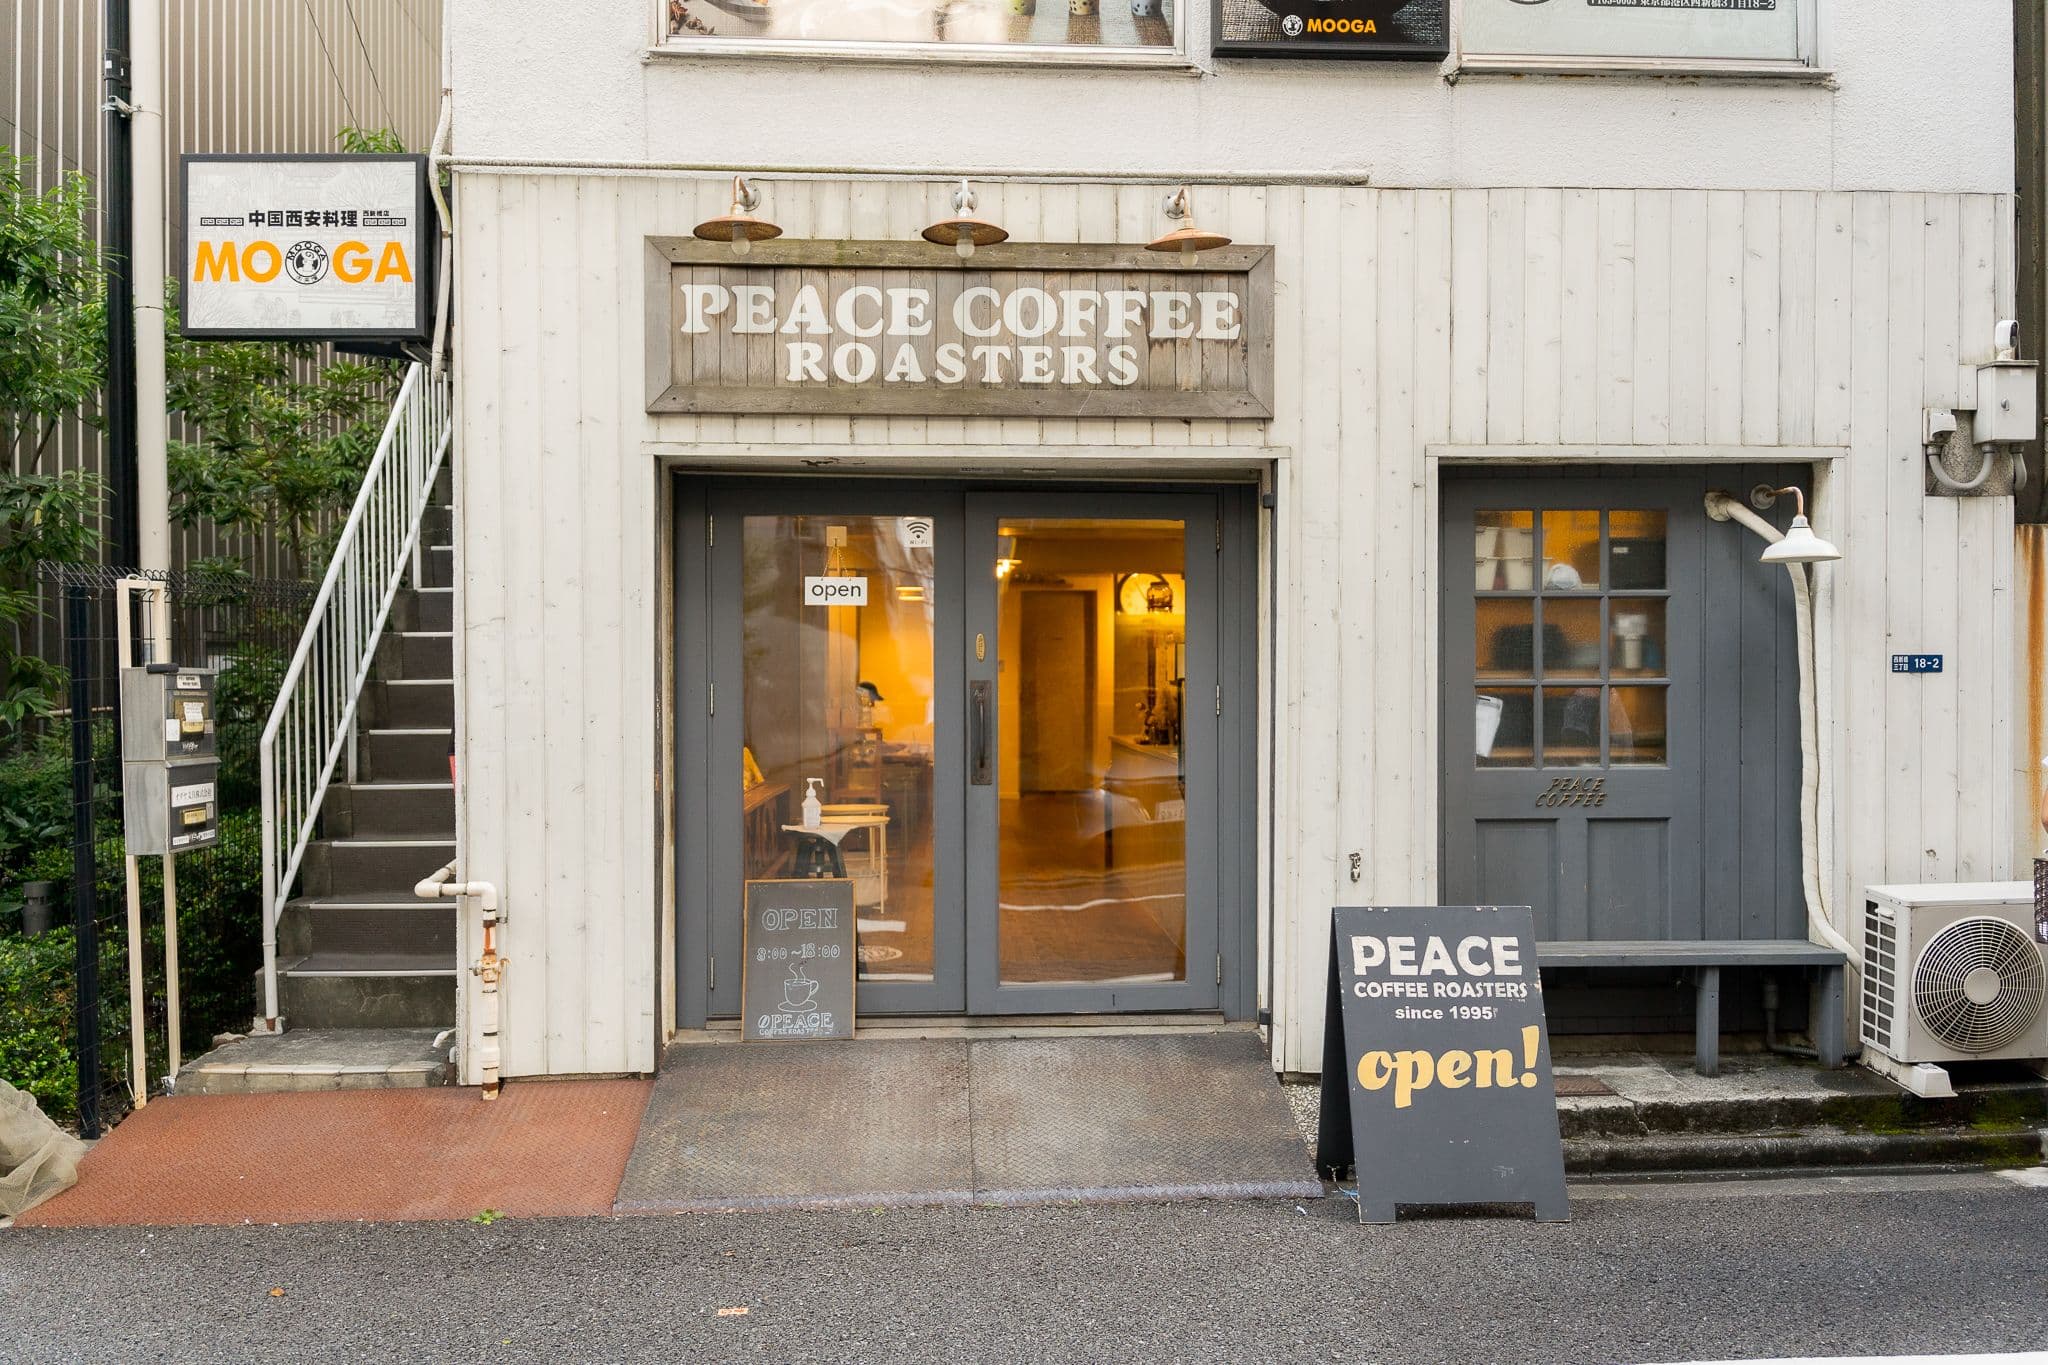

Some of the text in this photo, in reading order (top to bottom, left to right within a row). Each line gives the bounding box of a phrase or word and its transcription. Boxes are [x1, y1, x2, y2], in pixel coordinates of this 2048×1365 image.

[1307, 18, 1377, 33] MOOGA
[248, 210, 358, 227] 中国西安料理
[285, 241, 328, 261] MOOGA
[680, 283, 1242, 340] PEACE COFFEE
[786, 342, 1140, 386] ROASTERS
[811, 584, 862, 601] open
[1914, 657, 1940, 669] 18-2
[1547, 776, 1606, 792] PEACE
[1535, 791, 1608, 808] COFFEE
[761, 908, 839, 931] OPEN
[1351, 935, 1523, 977] PEACE
[1354, 981, 1528, 999] COFFEE ROASTERS
[1395, 1005, 1444, 1020] since
[1356, 1025, 1541, 1109] open!
